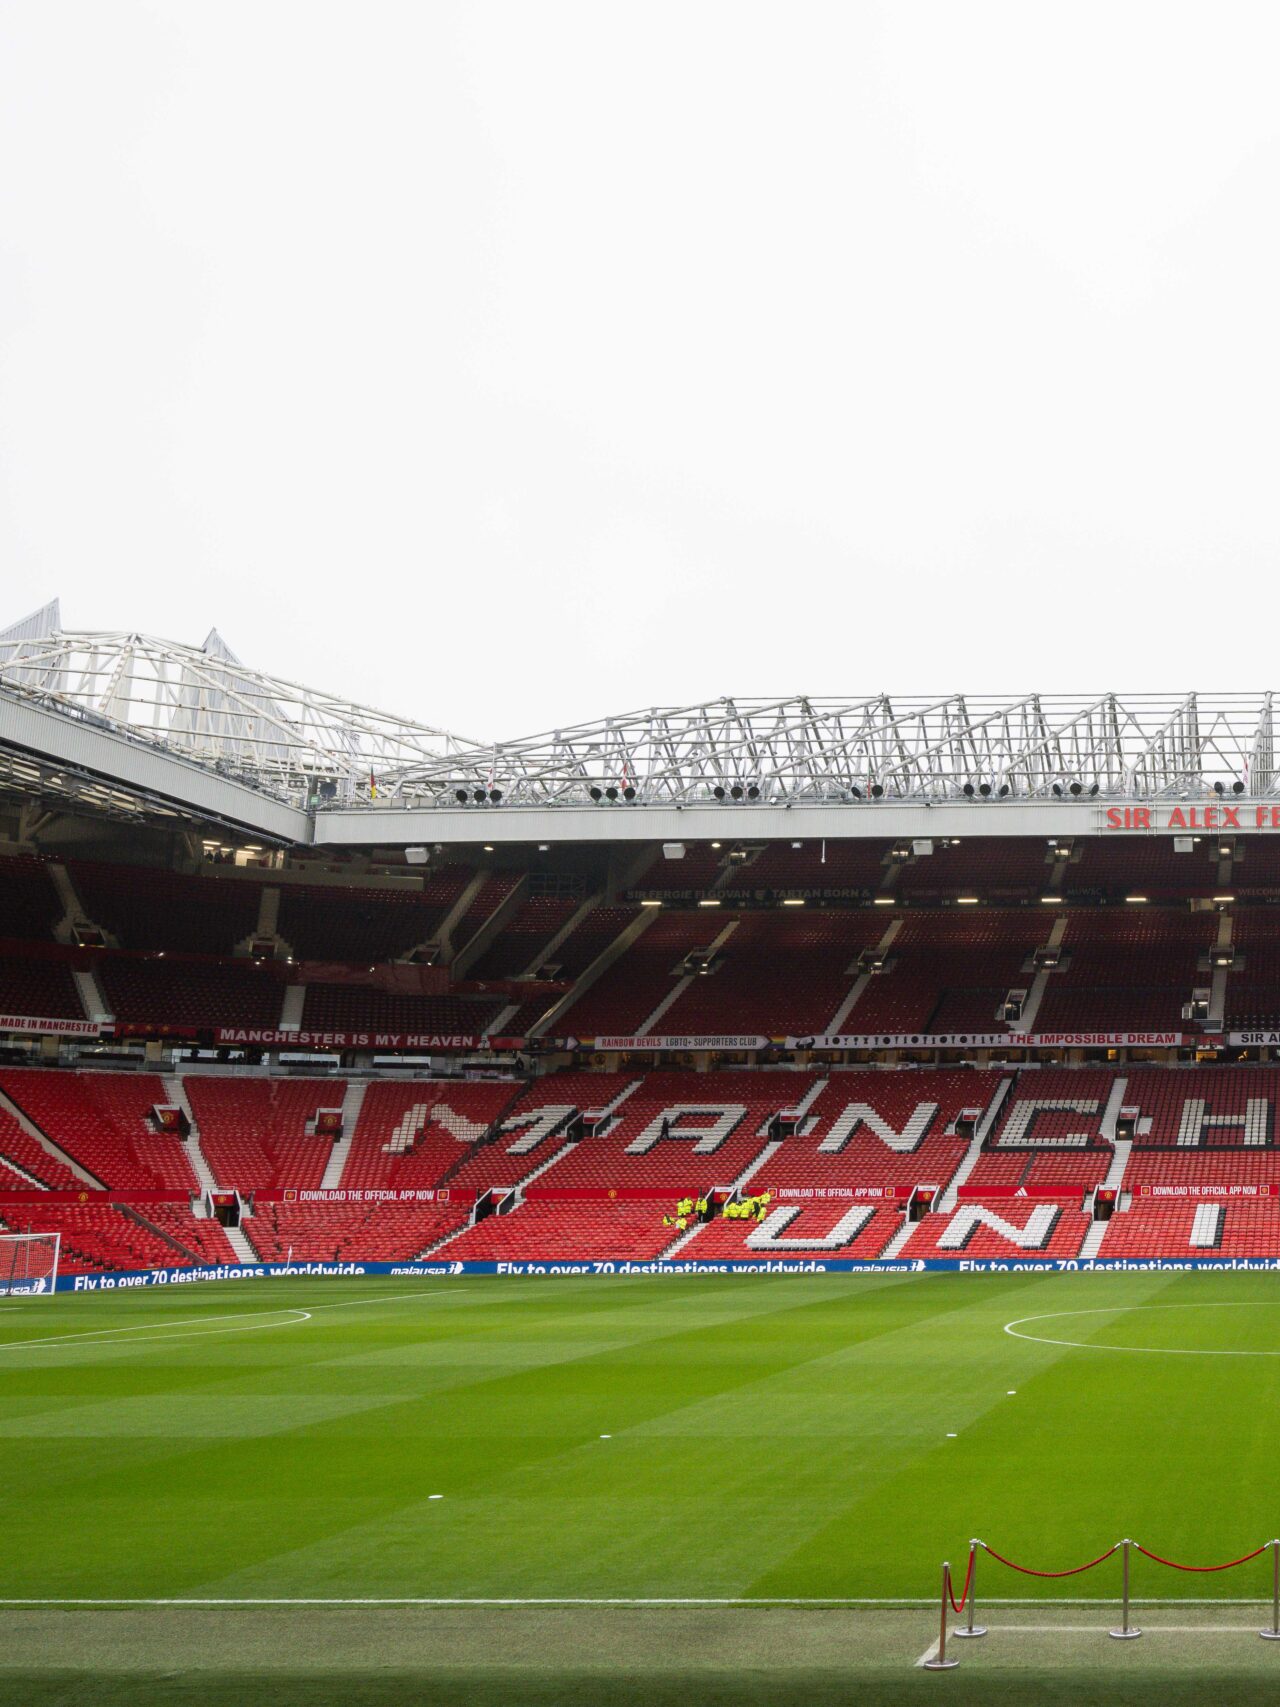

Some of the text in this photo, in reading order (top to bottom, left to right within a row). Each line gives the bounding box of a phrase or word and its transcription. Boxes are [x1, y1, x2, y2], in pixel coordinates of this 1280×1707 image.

[1106, 807, 1151, 829] SIR
[1168, 806, 1241, 828] ALEX
[626, 890, 647, 899] SIR
[649, 890, 692, 899] FERGIE
[772, 889, 821, 898] TARTAN
[823, 889, 860, 898] BORN
[0, 1017, 98, 1033] MADE IN MANCHESTER
[220, 1029, 473, 1047] MANCHESTER IS MY HEAVEN
[601, 1038, 636, 1047] RAINBOW
[637, 1038, 662, 1047] DEVILS
[693, 1038, 738, 1046] SUPPORTERS
[739, 1037, 757, 1046] CLUB
[1008, 1033, 1176, 1045] THE IMPOSSIBLE DREAM
[1241, 1033, 1262, 1043] SIR
[300, 1190, 434, 1201] DOWNLOAD THE OFFICIAL APP NOW
[779, 1188, 883, 1198] DOWNLOAD THE OFFICIAL APP NOW
[1153, 1186, 1257, 1196] DOWNLOAD THE OFFICIAL APP NOW
[497, 1261, 825, 1274] Fly to over 70 destinations worldwide
[960, 1261, 985, 1272] Fly
[990, 1262, 1008, 1272] to
[1013, 1264, 1052, 1272] over
[1057, 1260, 1078, 1271] 70
[1083, 1260, 1192, 1271] destinations
[75, 1263, 365, 1291] Fly to over 70 destinations worldwide
